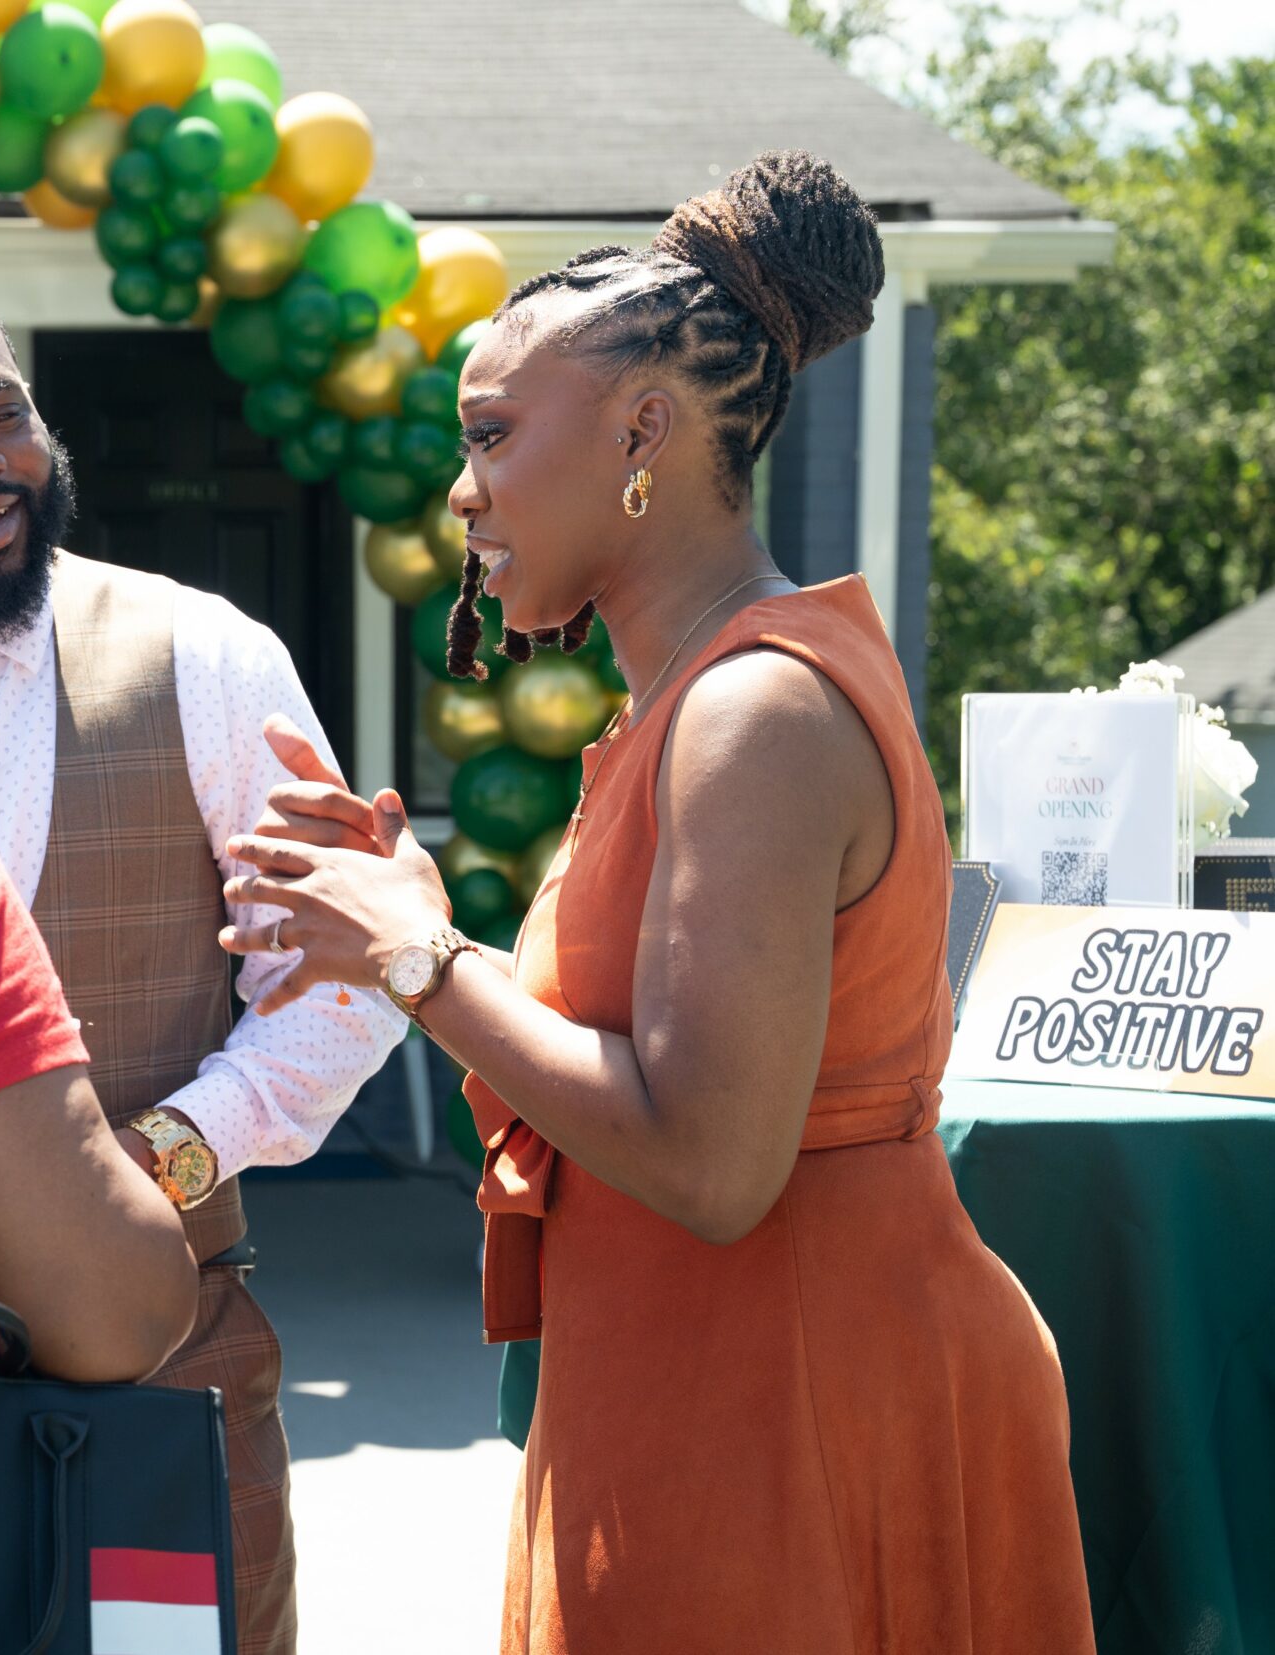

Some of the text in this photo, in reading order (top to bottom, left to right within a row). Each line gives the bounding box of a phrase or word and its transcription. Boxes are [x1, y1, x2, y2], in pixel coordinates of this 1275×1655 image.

[1045, 776, 1104, 795] GRAND
[1038, 799, 1113, 819] OPENING
[1071, 928, 1230, 998] STAY
[996, 996, 1264, 1075] POSITIVE
